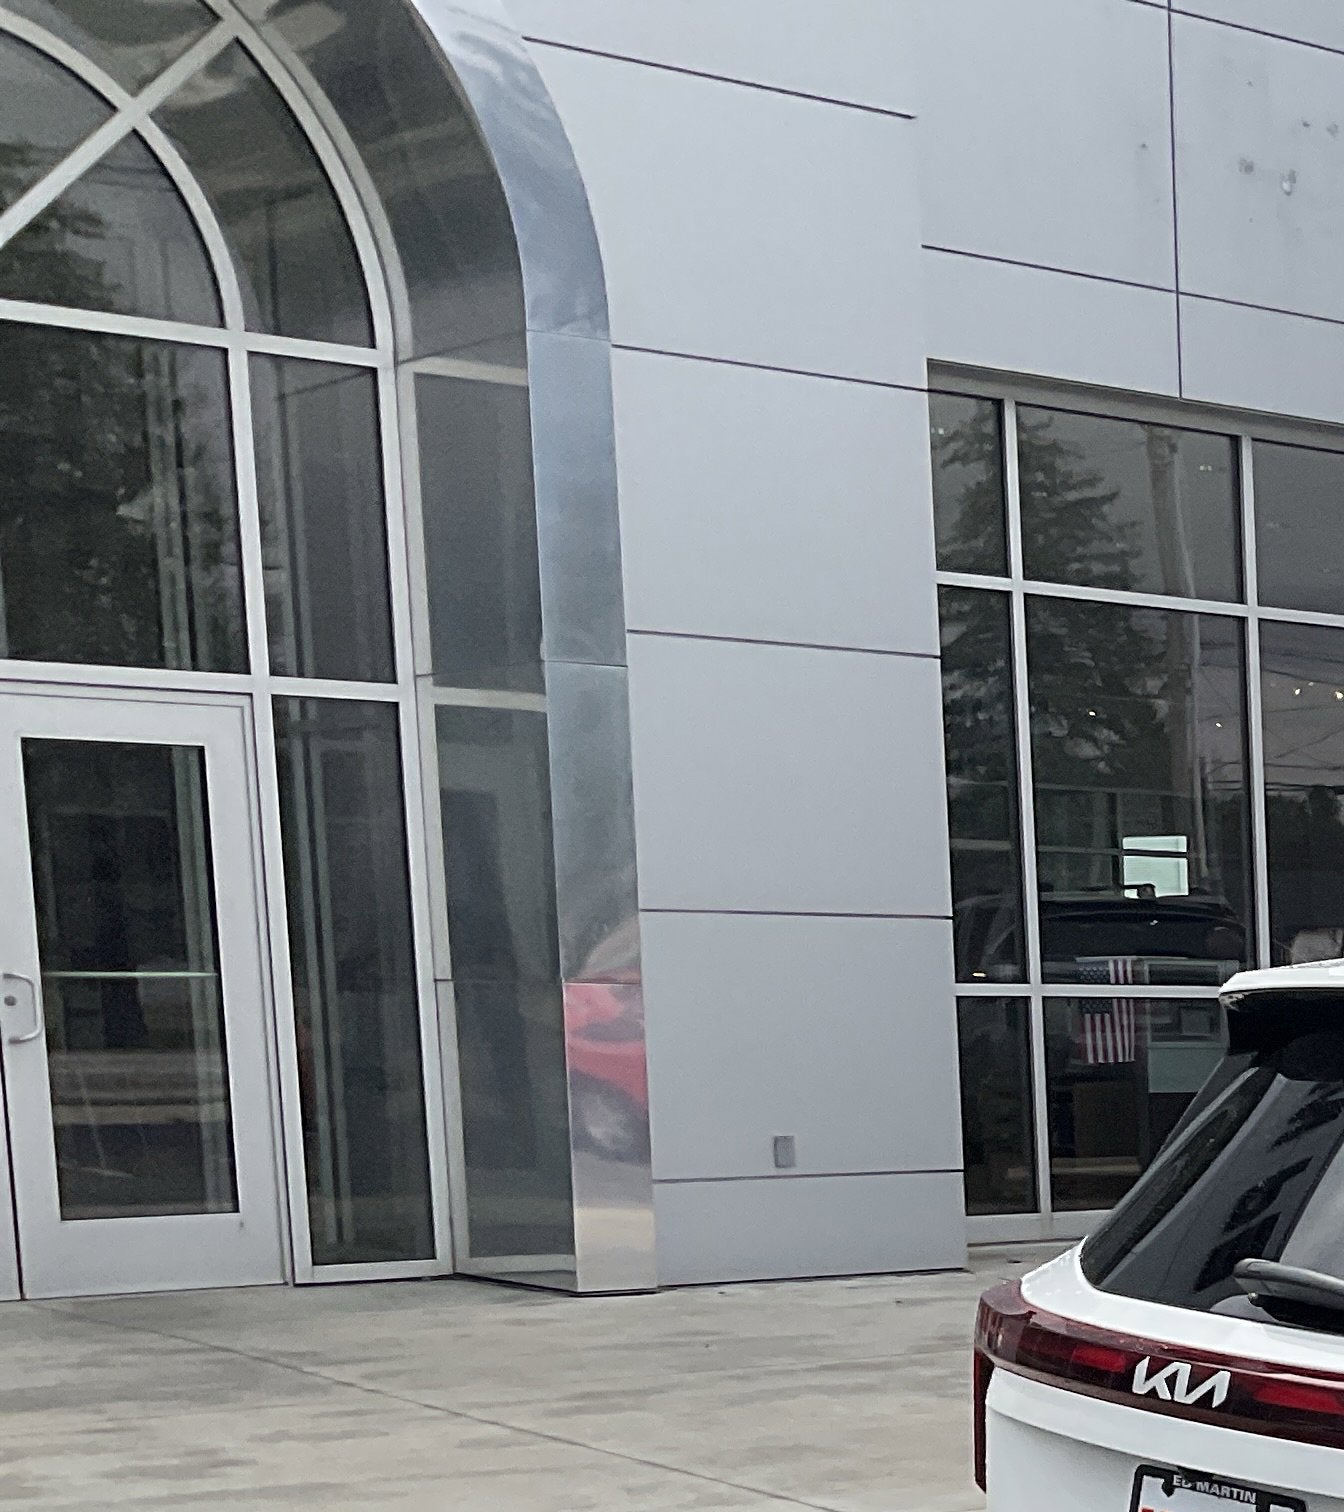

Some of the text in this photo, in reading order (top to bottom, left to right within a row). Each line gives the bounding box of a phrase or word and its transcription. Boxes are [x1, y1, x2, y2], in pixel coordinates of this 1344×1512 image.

[1132, 1356, 1231, 1408] KIA
[1173, 1475, 1257, 1504] ED MARTIN
